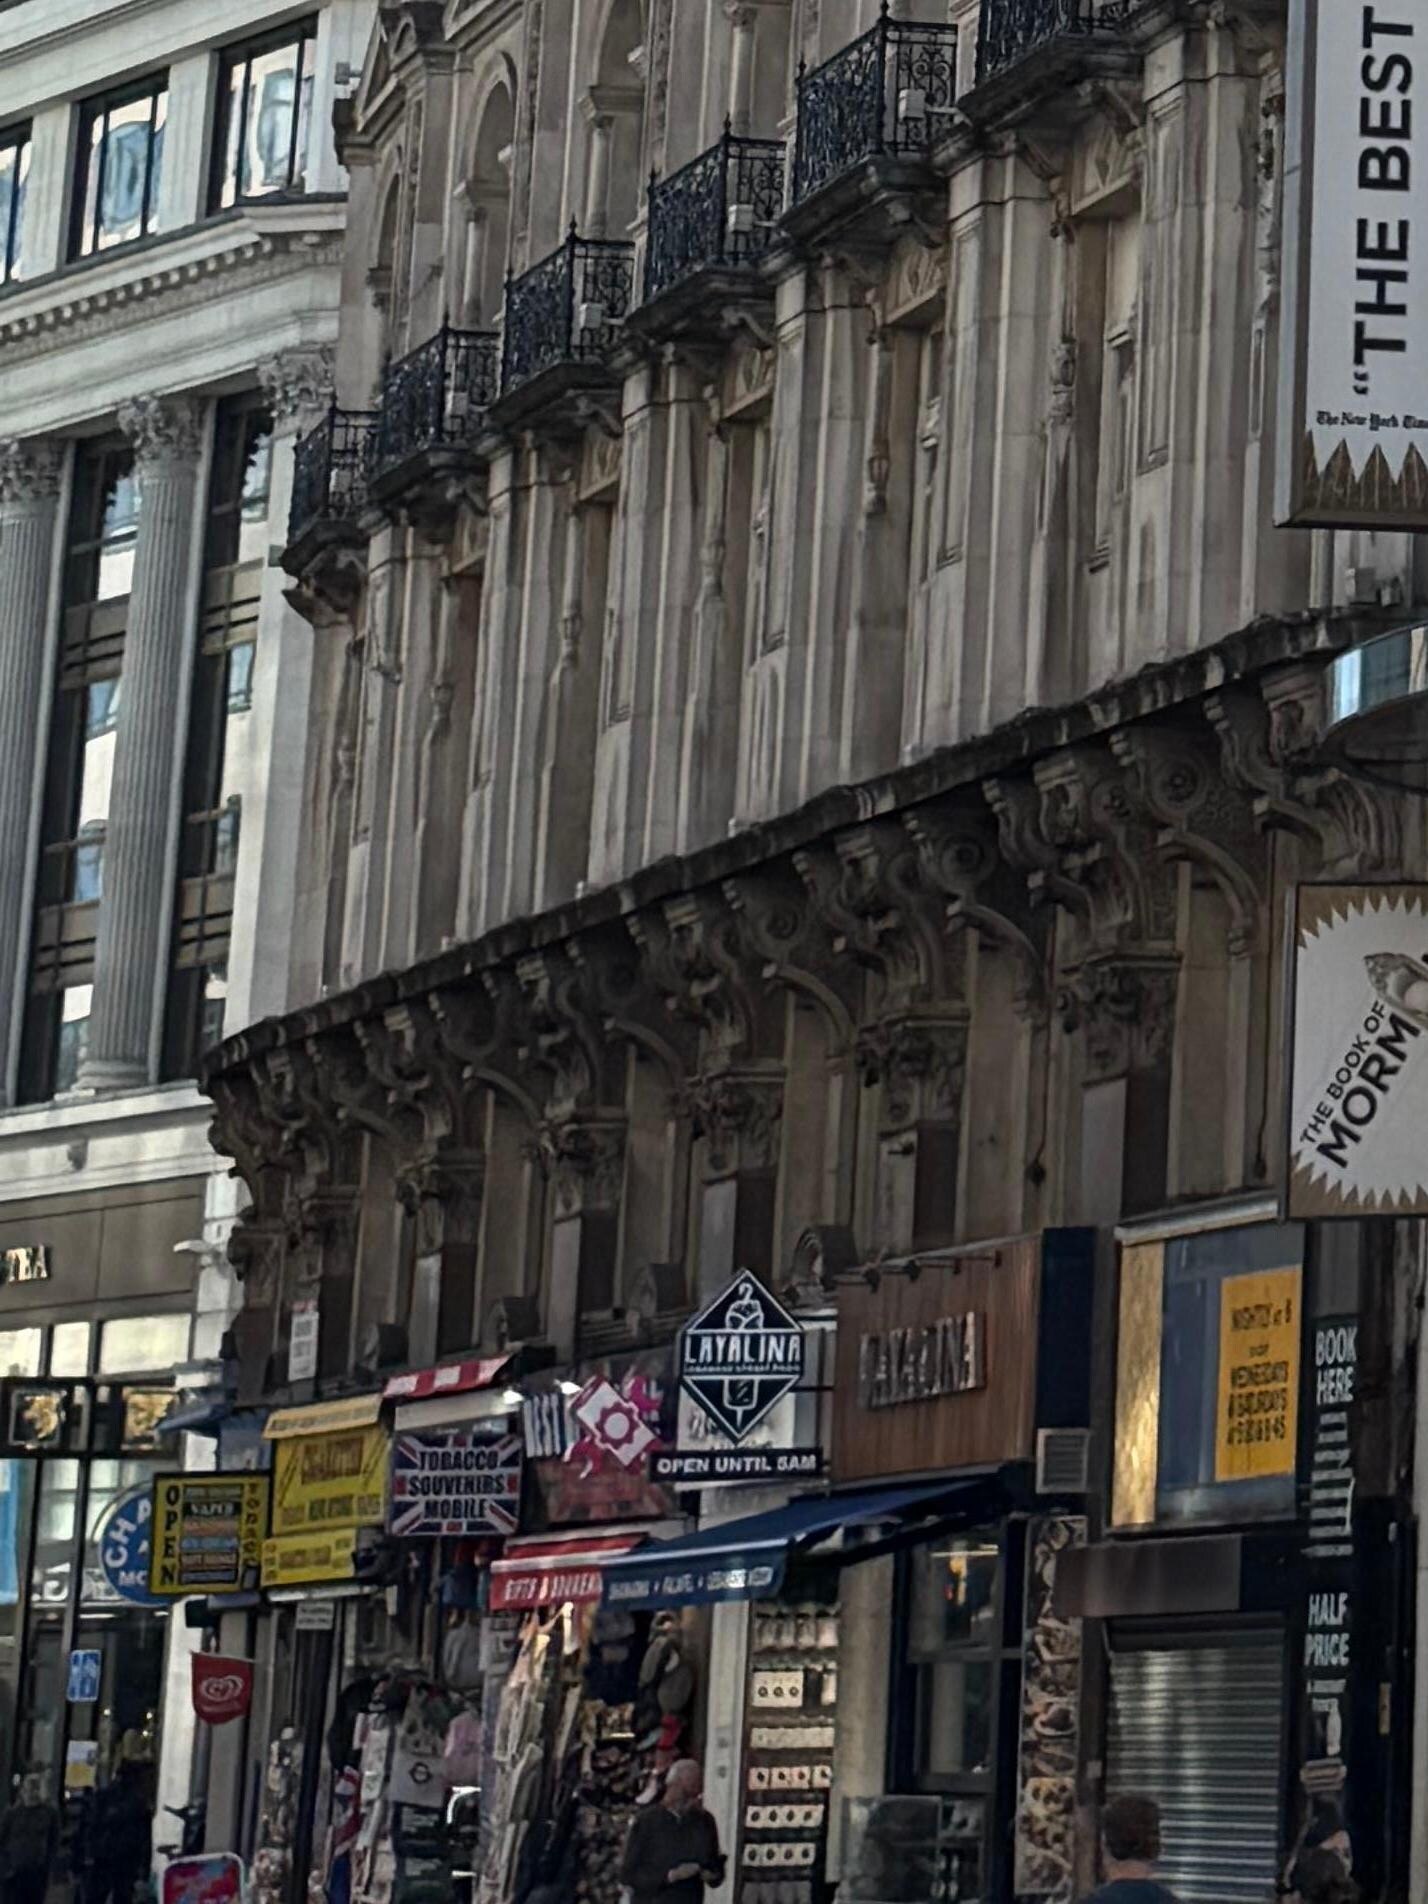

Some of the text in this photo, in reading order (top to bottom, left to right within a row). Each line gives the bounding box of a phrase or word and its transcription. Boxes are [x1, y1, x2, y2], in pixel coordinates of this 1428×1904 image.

[1360, 6, 1414, 194] BEST
[1300, 1000, 1389, 1146] THE BOOK OF
[685, 1334, 801, 1364] LAYALINA
[1315, 1326, 1358, 1367] BOOK
[1317, 1365, 1354, 1406] HERE
[420, 1450, 499, 1471] TOBACCO
[656, 1456, 710, 1473] OPEN
[715, 1456, 772, 1473] UNTIL
[408, 1474, 505, 1496] SOUVENIRS
[424, 1497, 487, 1519] MOBILE
[160, 1484, 181, 1586] OPEN
[1308, 1591, 1349, 1626] HALF
[1304, 1632, 1350, 1667] PRICE
